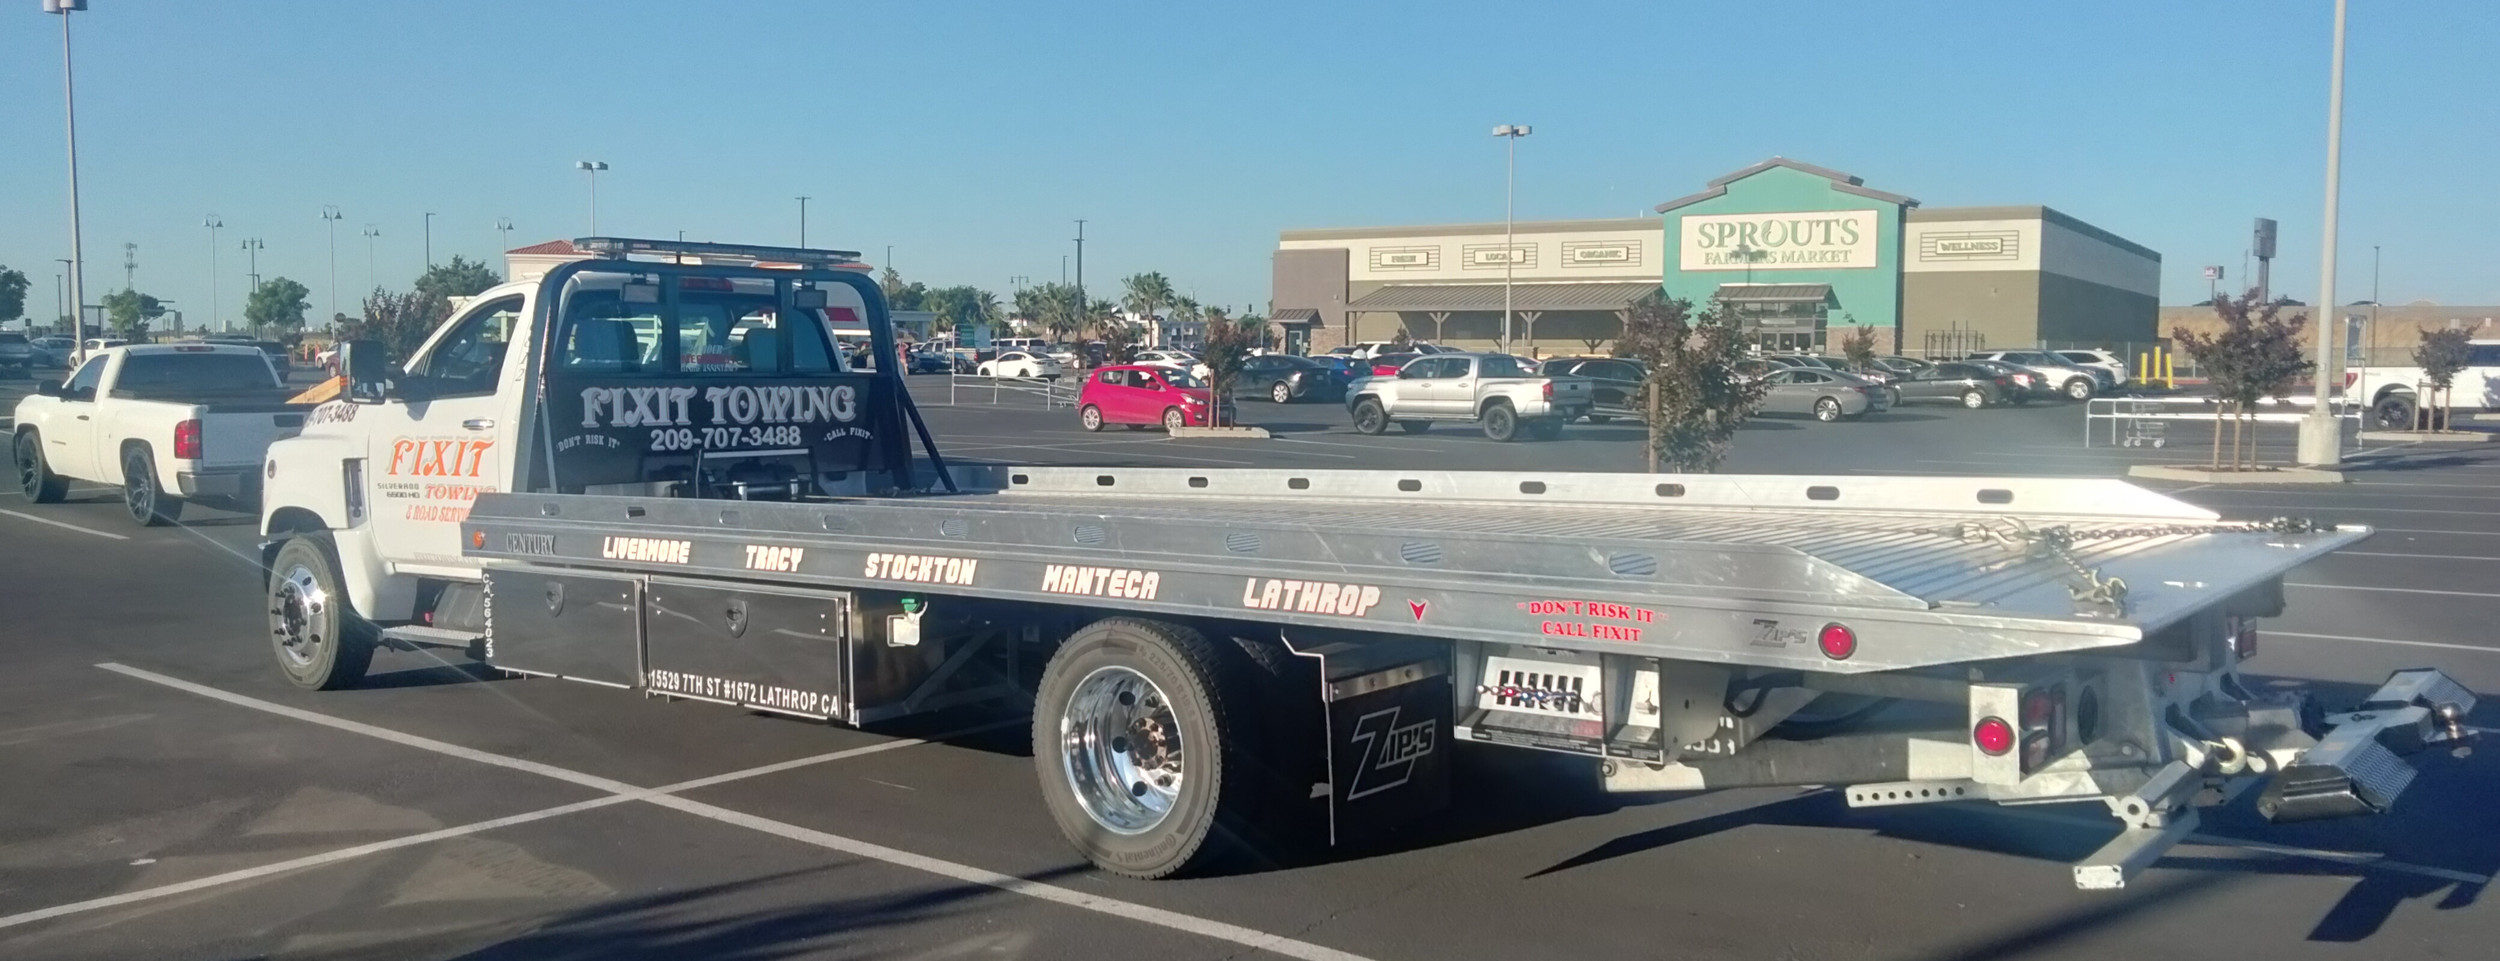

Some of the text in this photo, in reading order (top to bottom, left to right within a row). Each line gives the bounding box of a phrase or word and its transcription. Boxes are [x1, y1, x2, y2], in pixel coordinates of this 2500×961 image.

[1697, 218, 1860, 249] SPROUTS
[1940, 241, 1999, 251] WELLNESS
[1780, 249, 1852, 264] MARKET
[581, 385, 857, 428] FIXIT TOWING
[585, 434, 605, 446] RISK
[650, 426, 803, 451] 209-707-3488
[385, 434, 496, 477] FIXIT
[412, 504, 439, 521] ROAD
[506, 533, 555, 555] CENTURY
[602, 536, 691, 564] LIVERMORE
[745, 545, 804, 572] TRACY
[864, 552, 978, 586] STOCKTON
[1041, 564, 1161, 600] MANTECA
[1242, 577, 1381, 617] LATHROP
[1588, 601, 1632, 620] RISK
[1541, 621, 1642, 642] CALL FIXIT
[650, 669, 840, 716] 15529 7TH ST #1672 LATHROP CA
